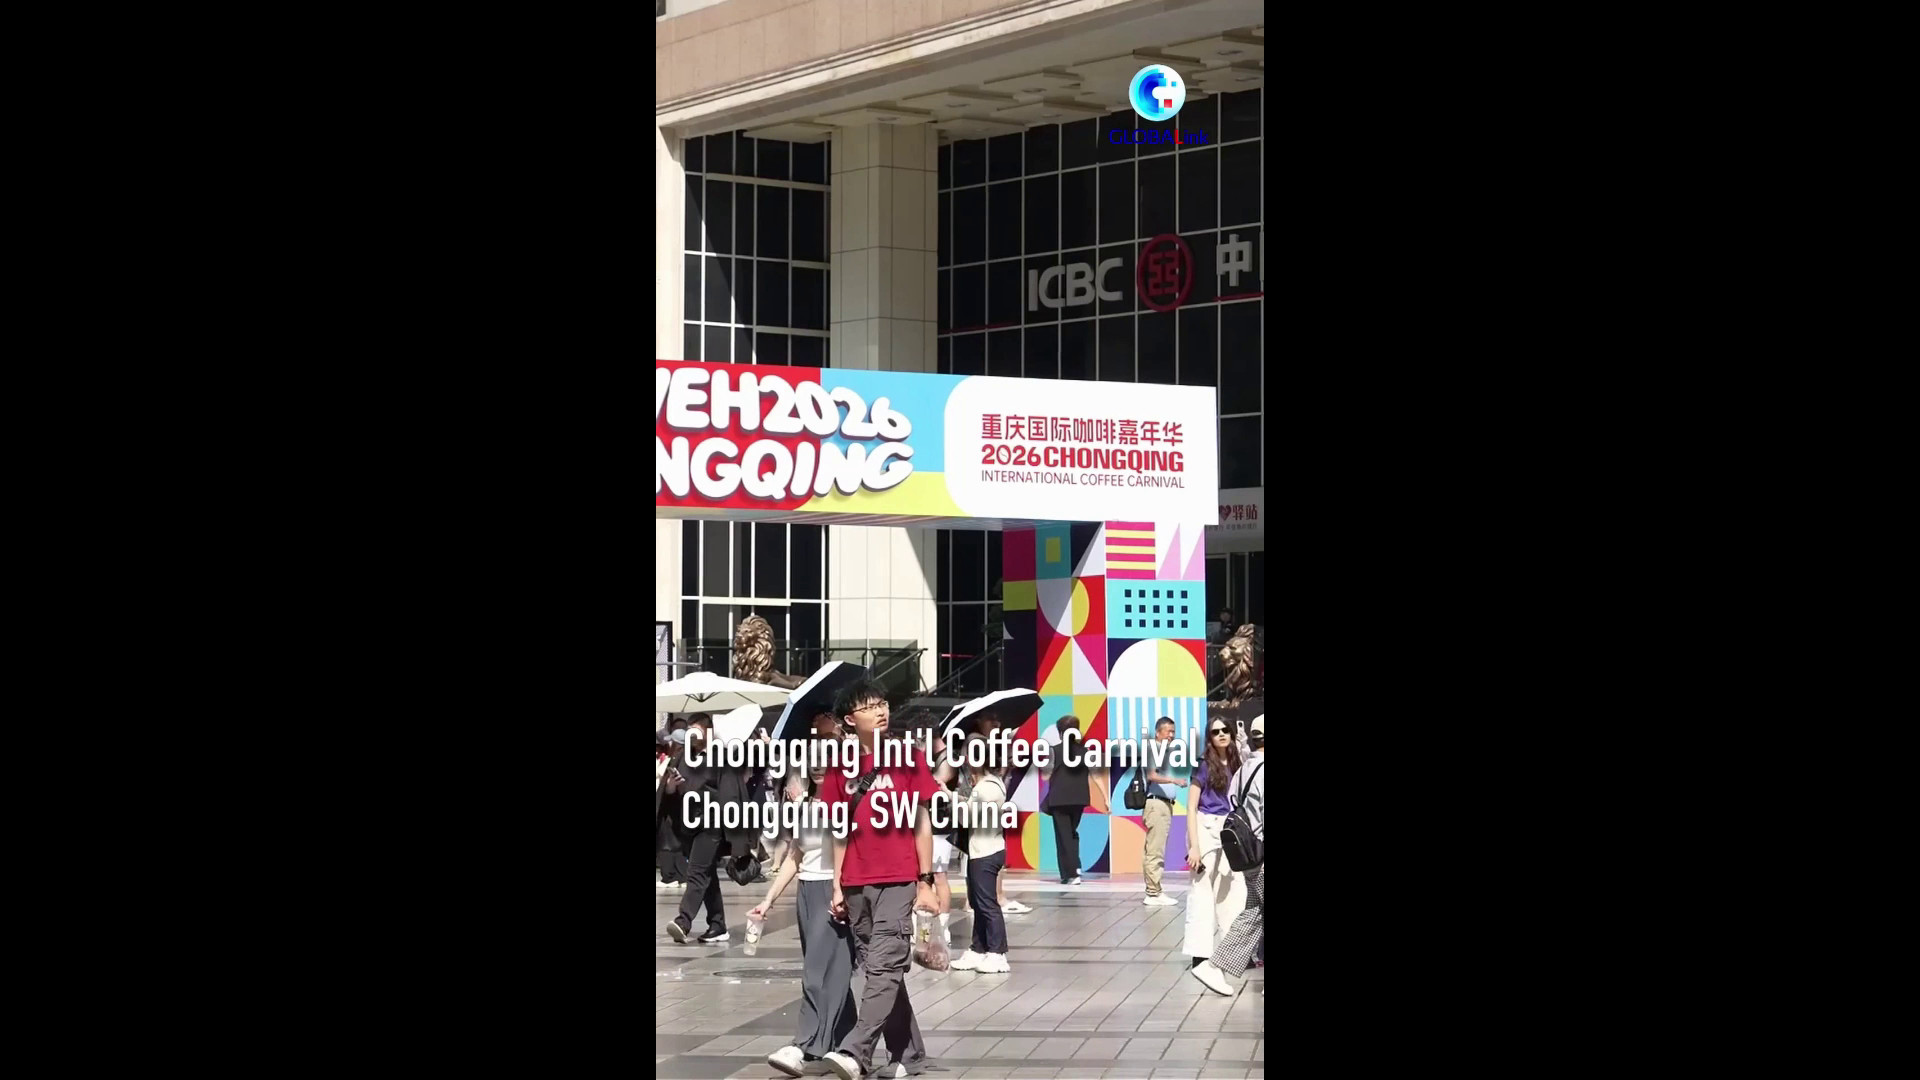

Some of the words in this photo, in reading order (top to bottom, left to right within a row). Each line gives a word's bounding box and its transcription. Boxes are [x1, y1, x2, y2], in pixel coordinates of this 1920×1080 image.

[1216, 231, 1264, 287] 中
[1028, 257, 1123, 311] ICBC
[981, 413, 1184, 447] 重庆国际咖啡嘉年华
[981, 470, 1078, 485] INTERNATIONAL
[1080, 473, 1124, 487] COFFEE
[1127, 475, 1185, 489] CARNIVAL
